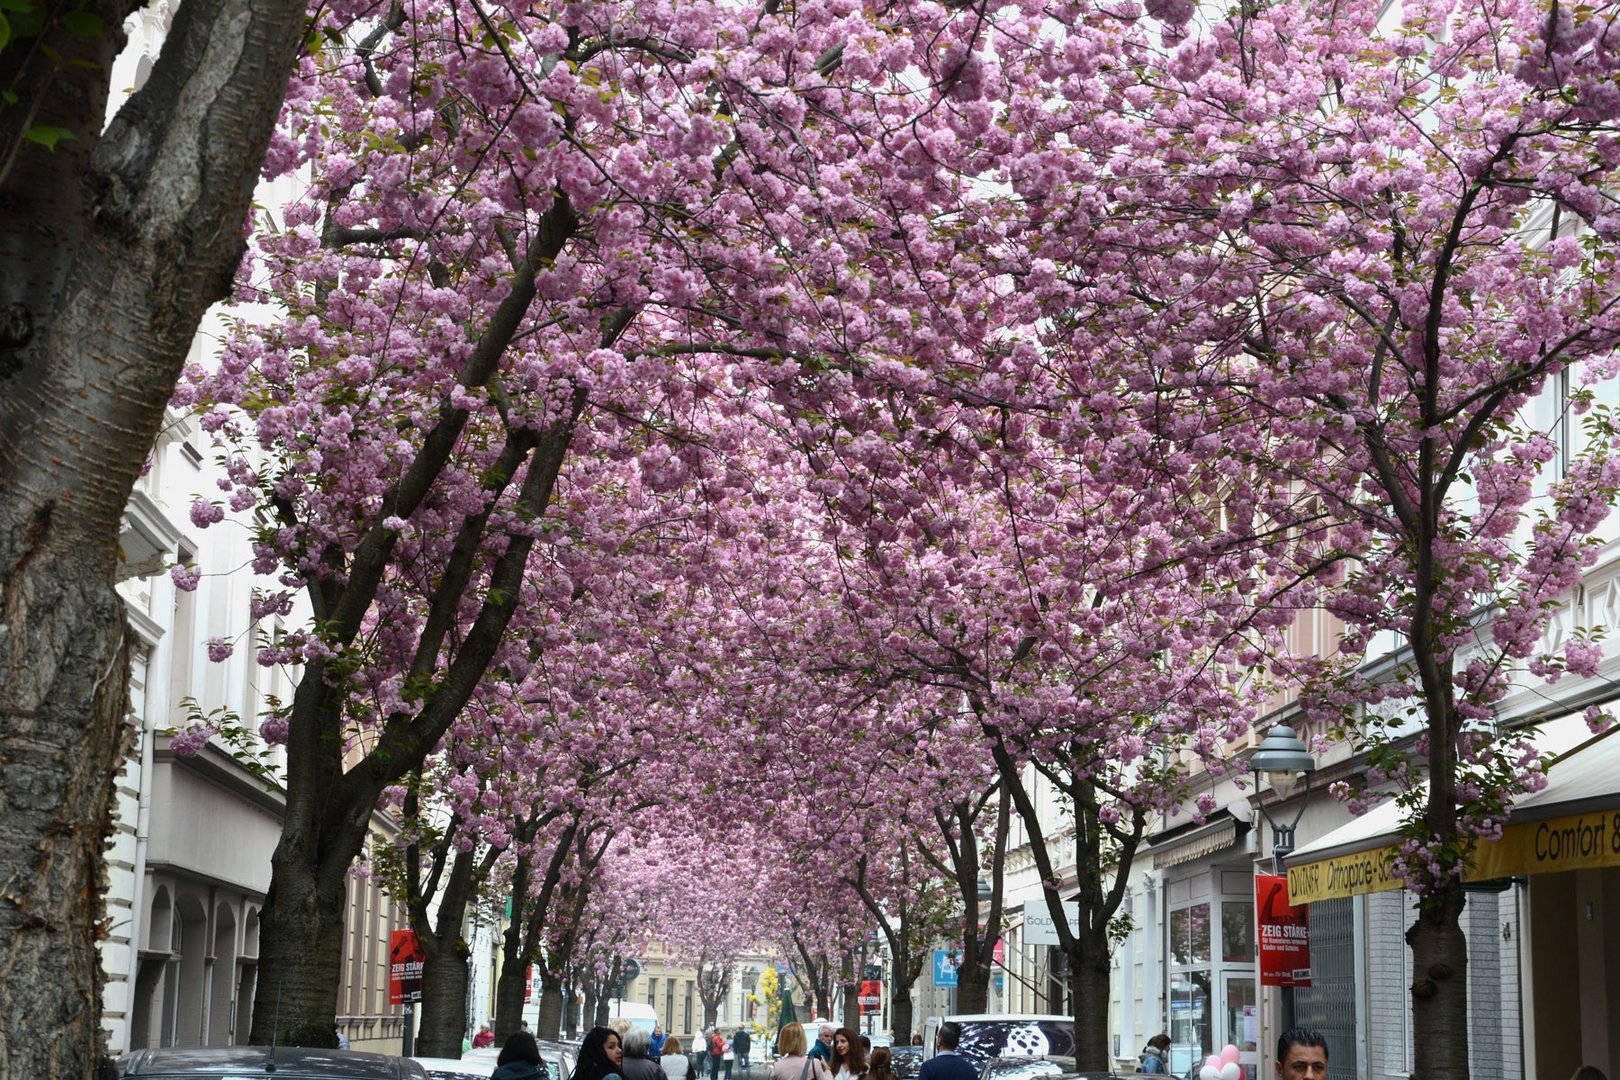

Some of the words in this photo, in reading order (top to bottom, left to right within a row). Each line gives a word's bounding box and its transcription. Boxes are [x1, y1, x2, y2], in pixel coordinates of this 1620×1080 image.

[1535, 814, 1606, 862] Comfort
[1262, 924, 1281, 937] ZEIG
[1283, 923, 1307, 938] STÄRKE
[391, 964, 404, 972] ZEIG
